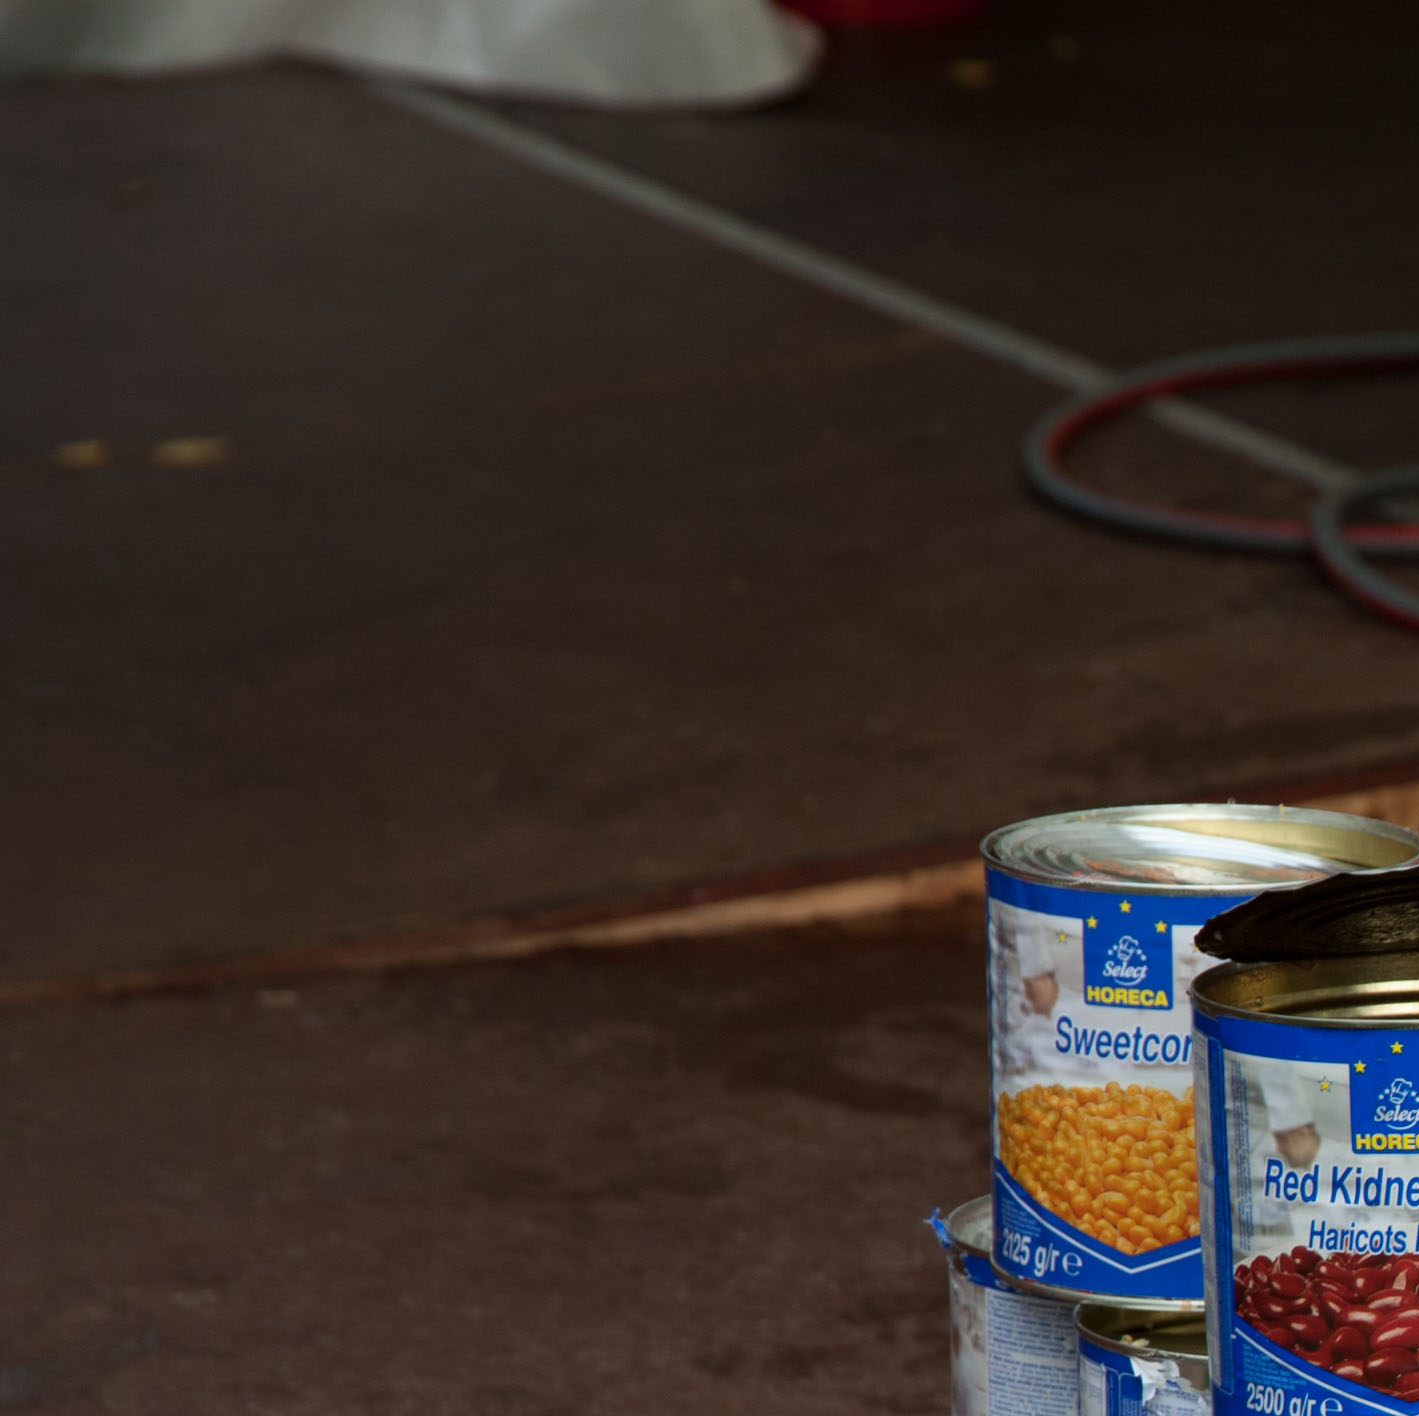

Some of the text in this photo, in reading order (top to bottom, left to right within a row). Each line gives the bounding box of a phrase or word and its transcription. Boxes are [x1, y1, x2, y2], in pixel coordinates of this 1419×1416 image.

[1103, 960, 1148, 980] Select
[1087, 985, 1168, 1007] HORECA
[1055, 1016, 1192, 1062] Sweetcor
[1264, 1158, 1320, 1202] Red
[1003, 1228, 1031, 1266] 2125
[1308, 1219, 1407, 1254] Haricots
[1247, 1383, 1285, 1416] 2500
